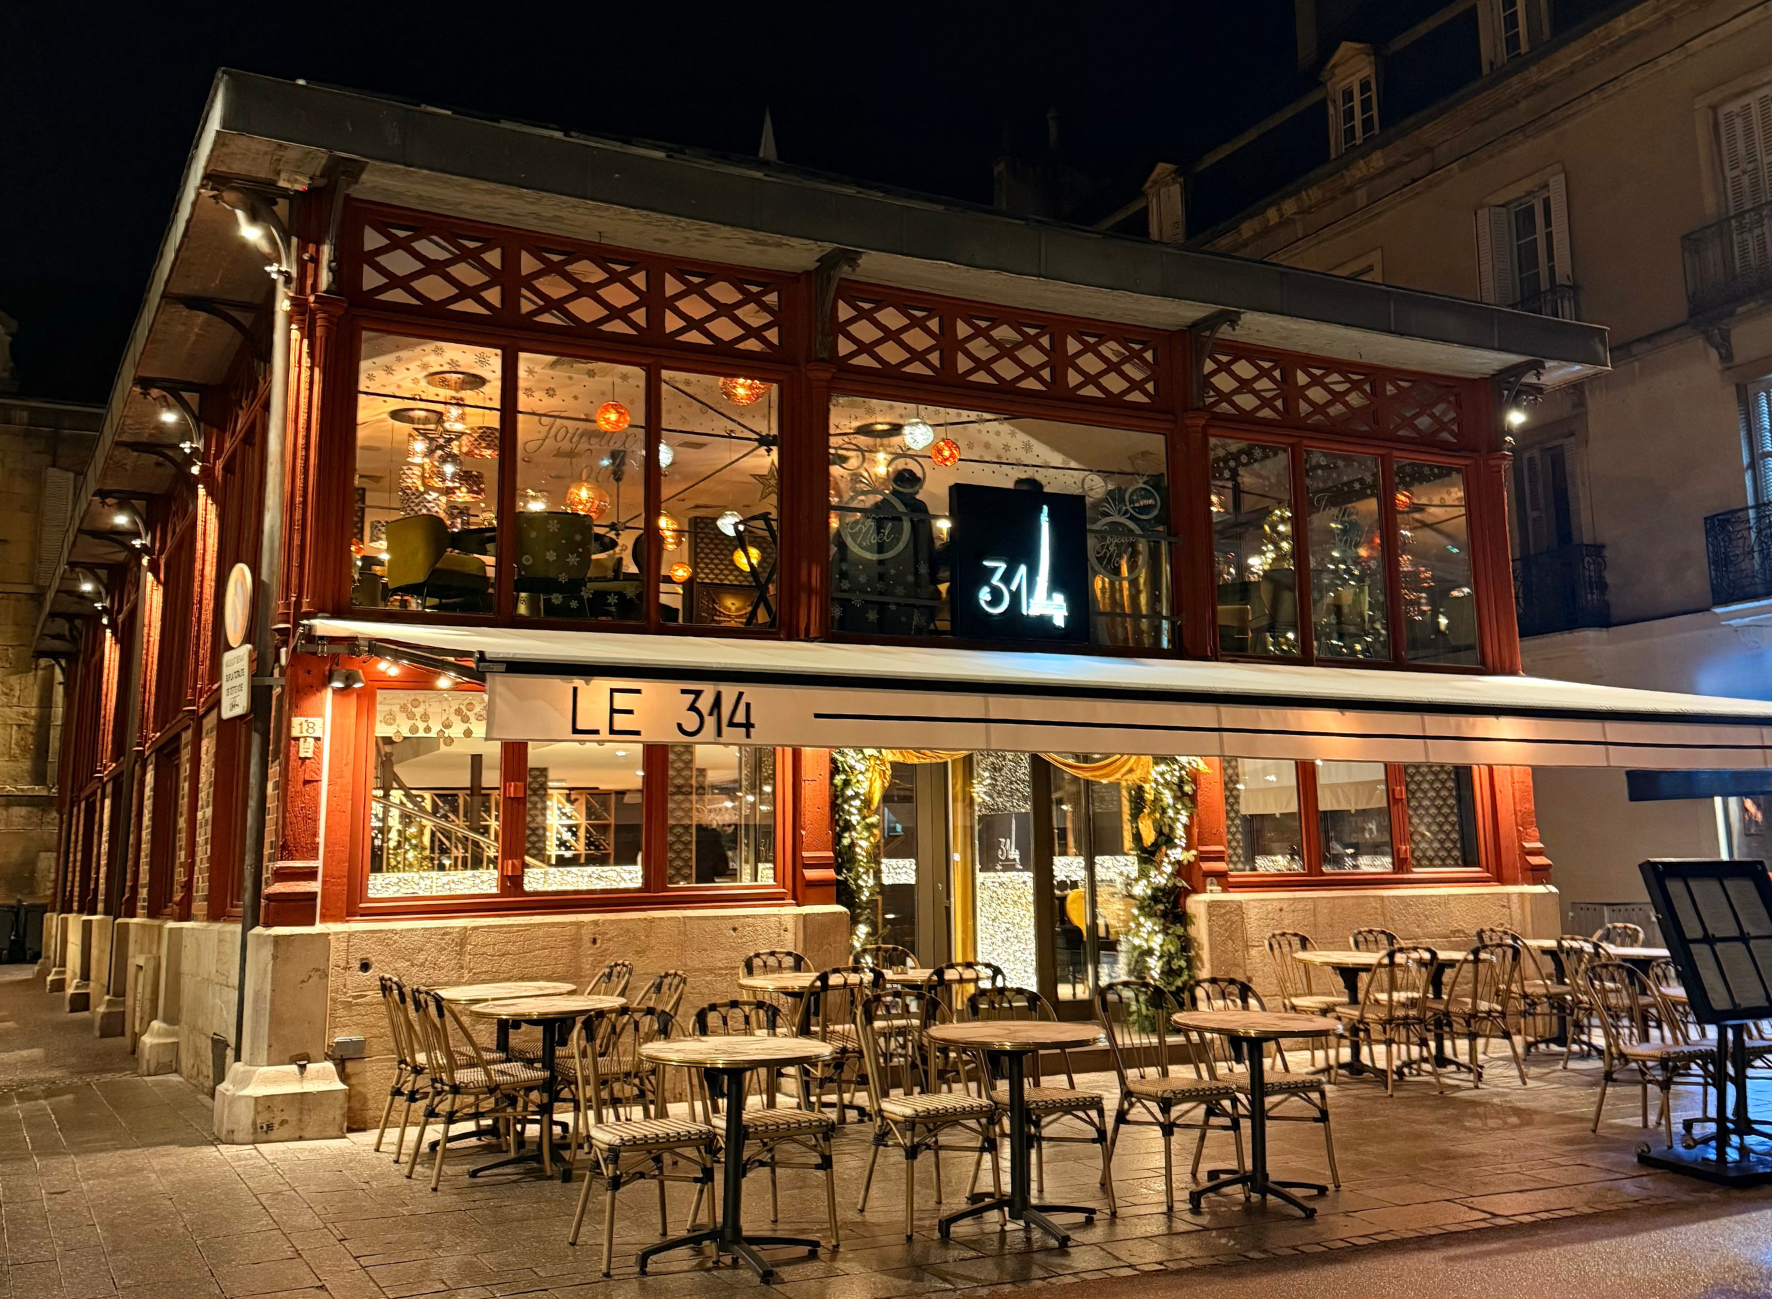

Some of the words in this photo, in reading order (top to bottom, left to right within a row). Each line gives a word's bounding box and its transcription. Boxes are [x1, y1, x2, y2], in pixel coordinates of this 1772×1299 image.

[978, 504, 1069, 628] 314
[298, 720, 316, 735] 18
[571, 685, 643, 736] LE
[676, 688, 756, 739] 314
